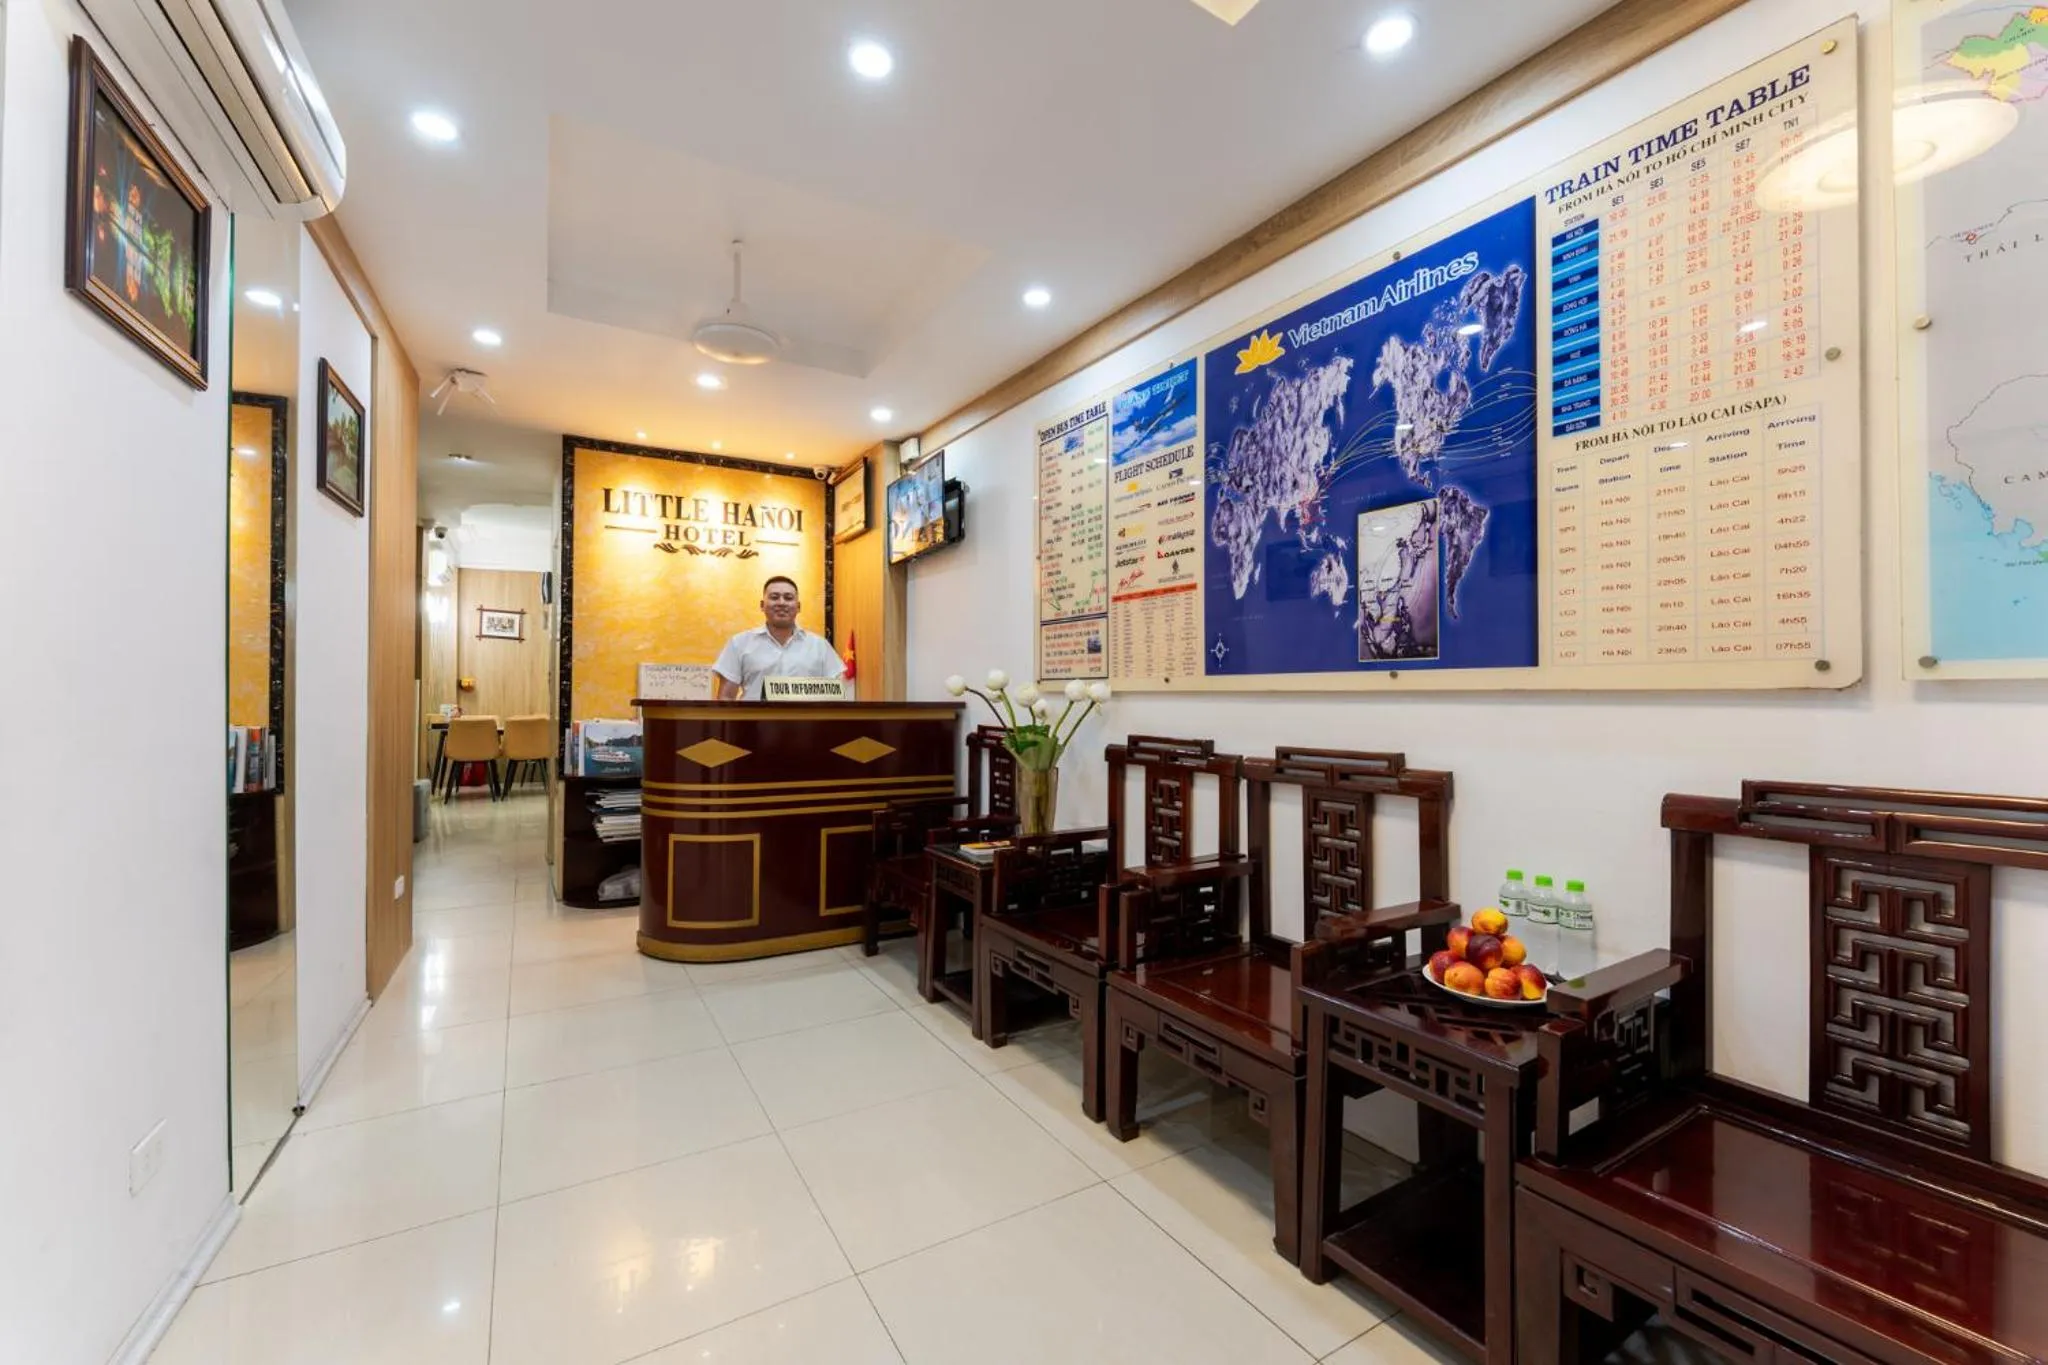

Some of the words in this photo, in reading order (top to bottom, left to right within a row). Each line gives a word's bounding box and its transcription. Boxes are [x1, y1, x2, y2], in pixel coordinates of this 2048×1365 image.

[1544, 156, 1621, 205] TRAIN
[1628, 118, 1699, 166] TIME
[1706, 64, 1811, 130] TABLE
[1558, 191, 1593, 215] FROM
[1643, 159, 1663, 179] TO
[1721, 113, 1764, 141] MINH
[1768, 92, 1810, 119] CITY
[1287, 297, 1379, 349] Vietnam
[1378, 251, 1480, 312] Airlines
[1575, 435, 1609, 452] FROM
[1659, 419, 1676, 433] TO
[1711, 405, 1737, 421] CAI
[1740, 395, 1788, 415] (SAPA)
[1705, 428, 1750, 443] Arriving
[1767, 414, 1816, 429] Arriving
[1708, 451, 1748, 463] Station
[1776, 440, 1806, 452] Time
[1114, 463, 1145, 484] FLIGHT
[1145, 444, 1194, 473] SCHEDULE
[602, 487, 709, 523] LITTLE
[722, 501, 804, 533] HANOI
[664, 524, 752, 547] HOTEL
[770, 681, 790, 695] TOUR
[791, 682, 842, 696] INFORMATION
